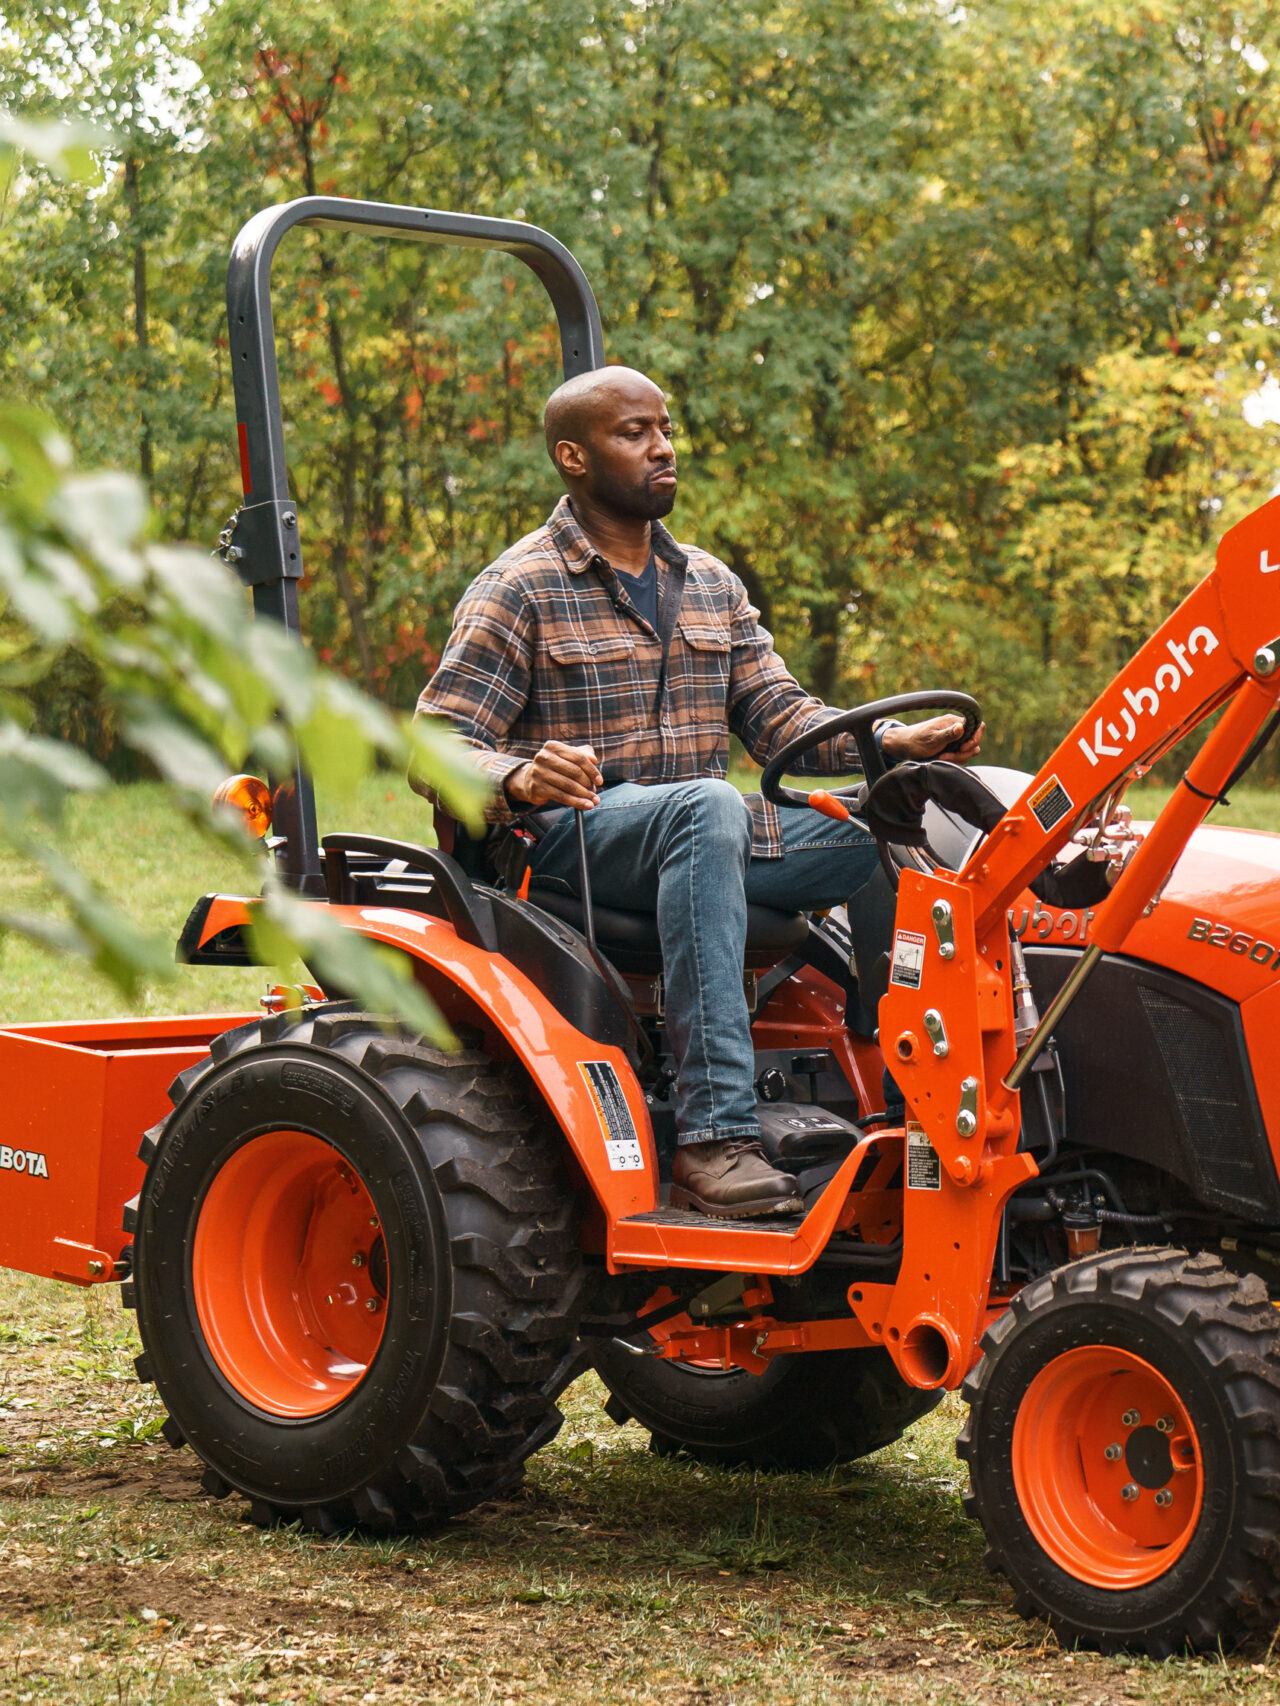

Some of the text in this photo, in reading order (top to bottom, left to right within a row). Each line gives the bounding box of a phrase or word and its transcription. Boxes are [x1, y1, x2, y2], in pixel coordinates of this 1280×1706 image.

[1077, 625, 1220, 767] Kubota
[902, 934, 924, 944] DANGER
[1007, 899, 1095, 941] ubot
[0, 1144, 50, 1180] BOTA
